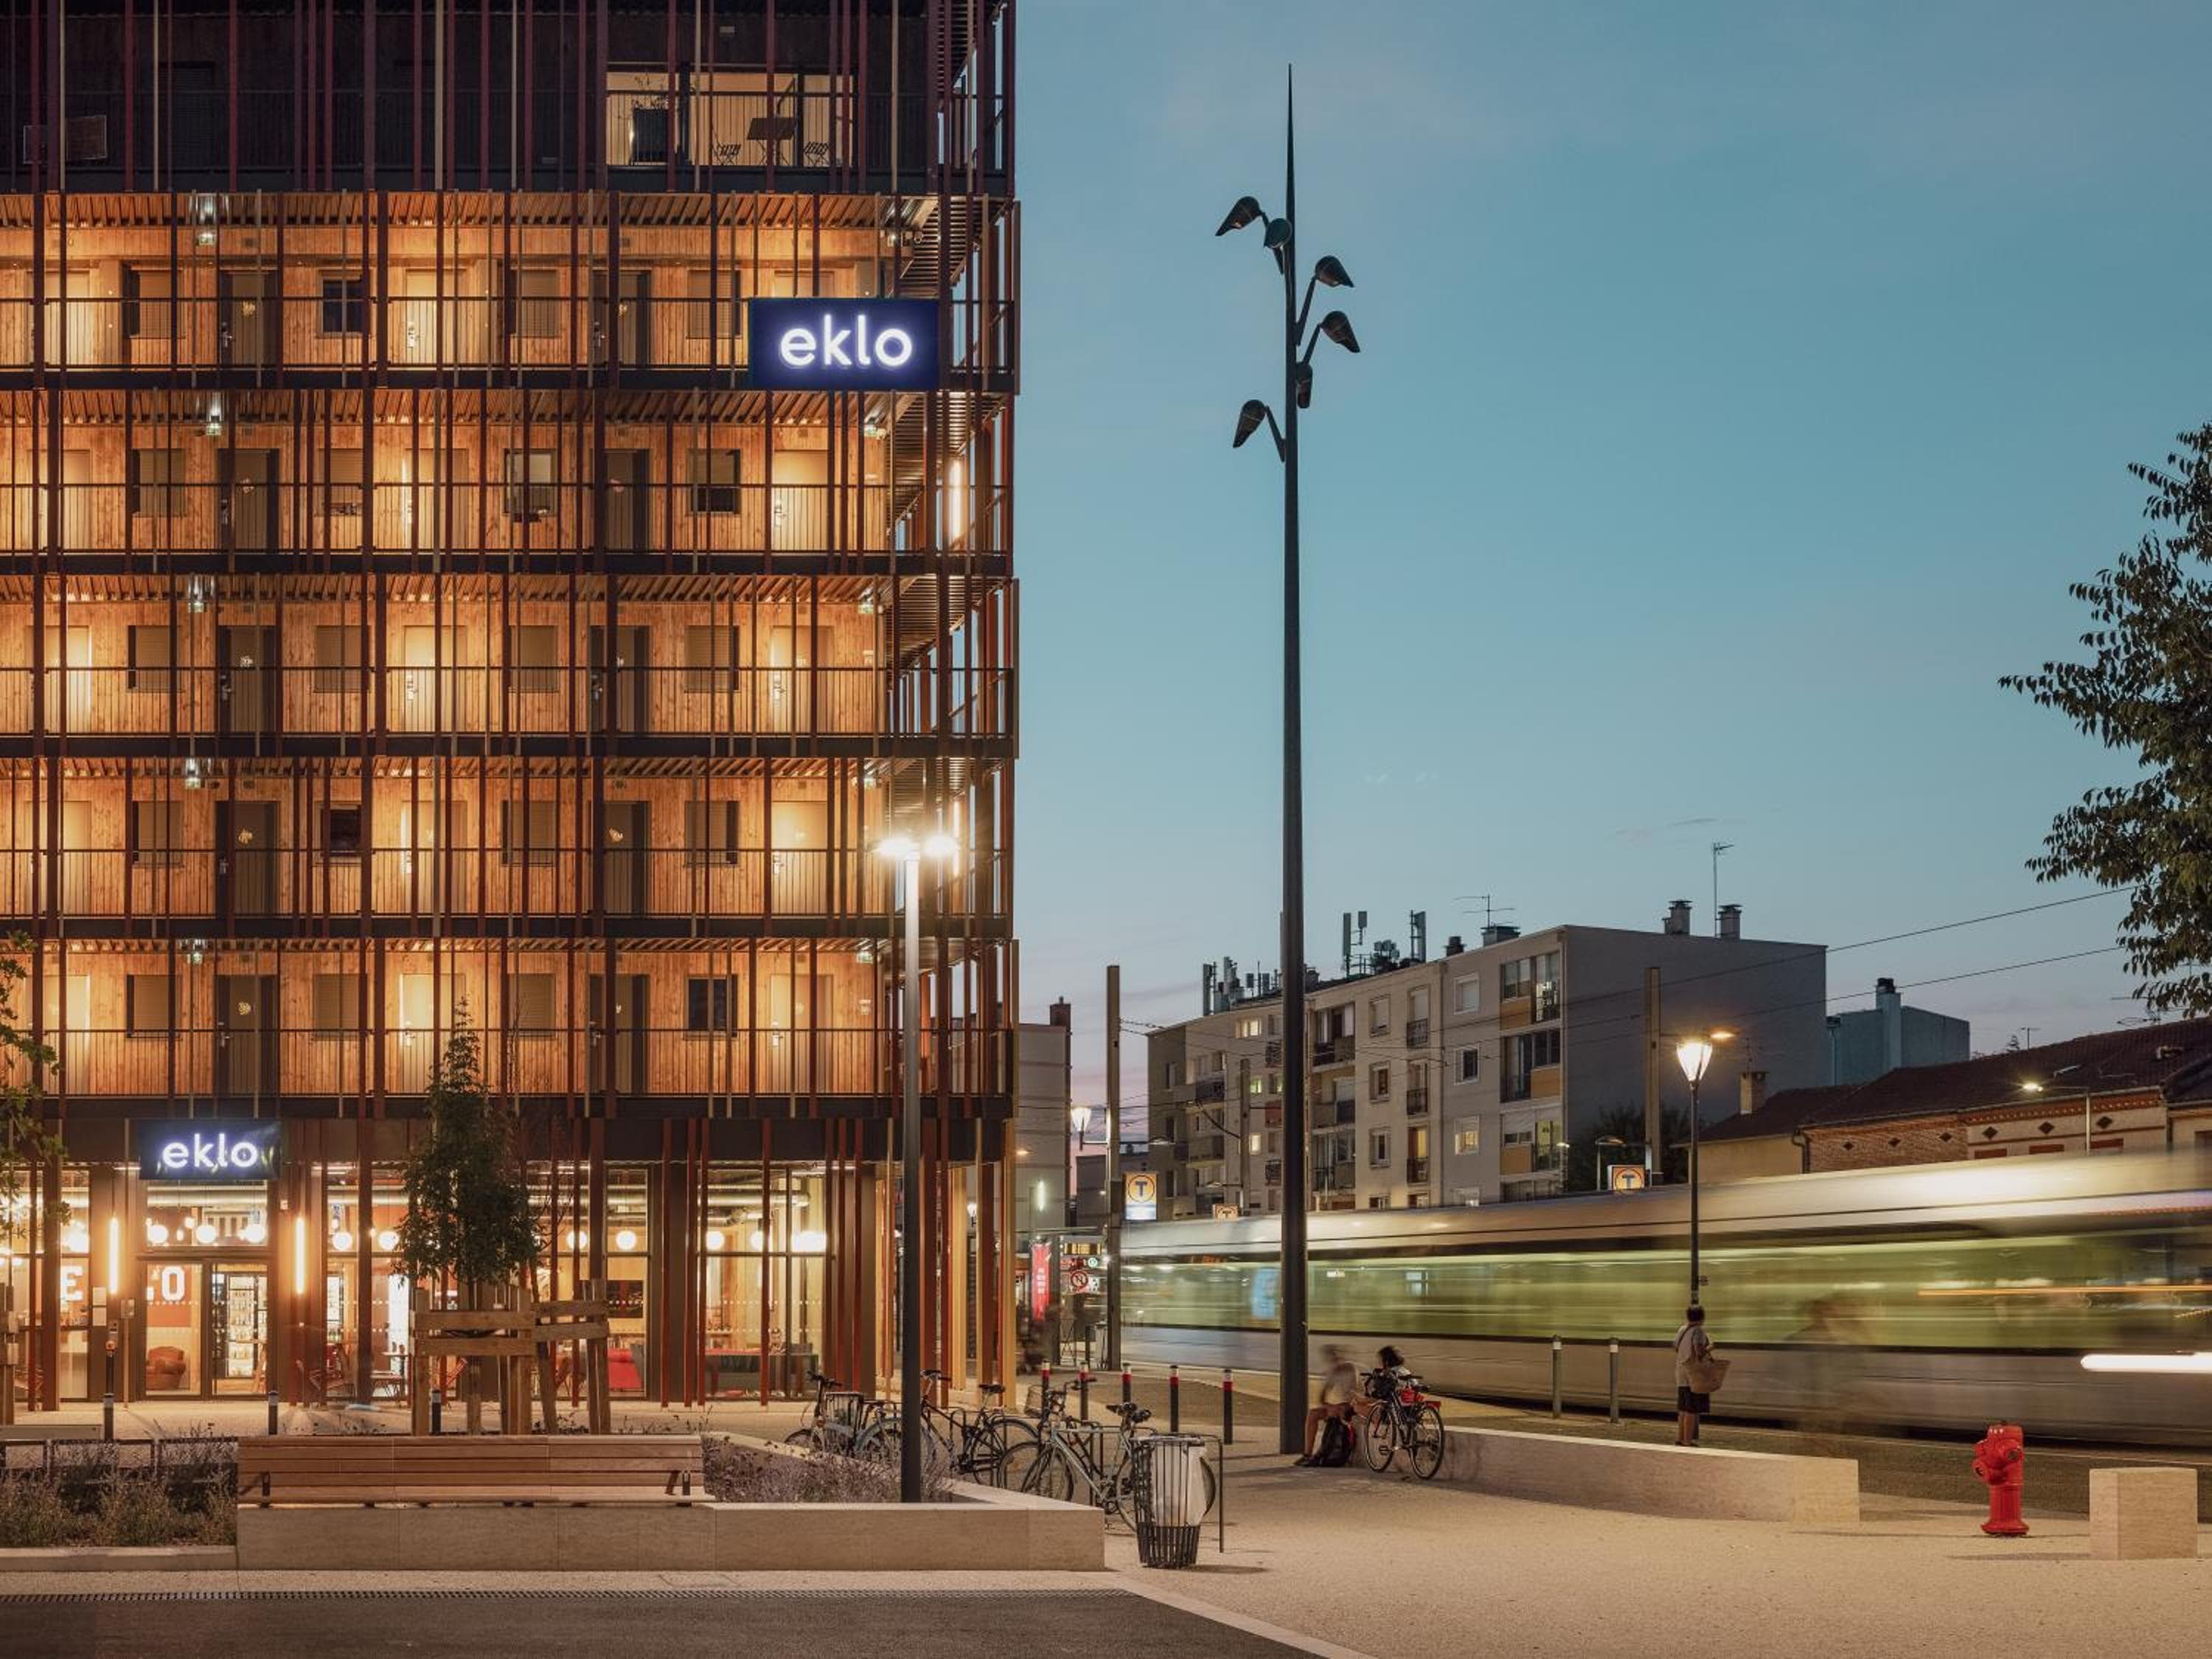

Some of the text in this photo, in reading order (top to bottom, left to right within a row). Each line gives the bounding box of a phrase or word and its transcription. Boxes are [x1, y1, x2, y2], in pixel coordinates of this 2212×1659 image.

[779, 313, 912, 366] eklo
[161, 1132, 258, 1169] eklo
[1135, 1180, 1147, 1197] T
